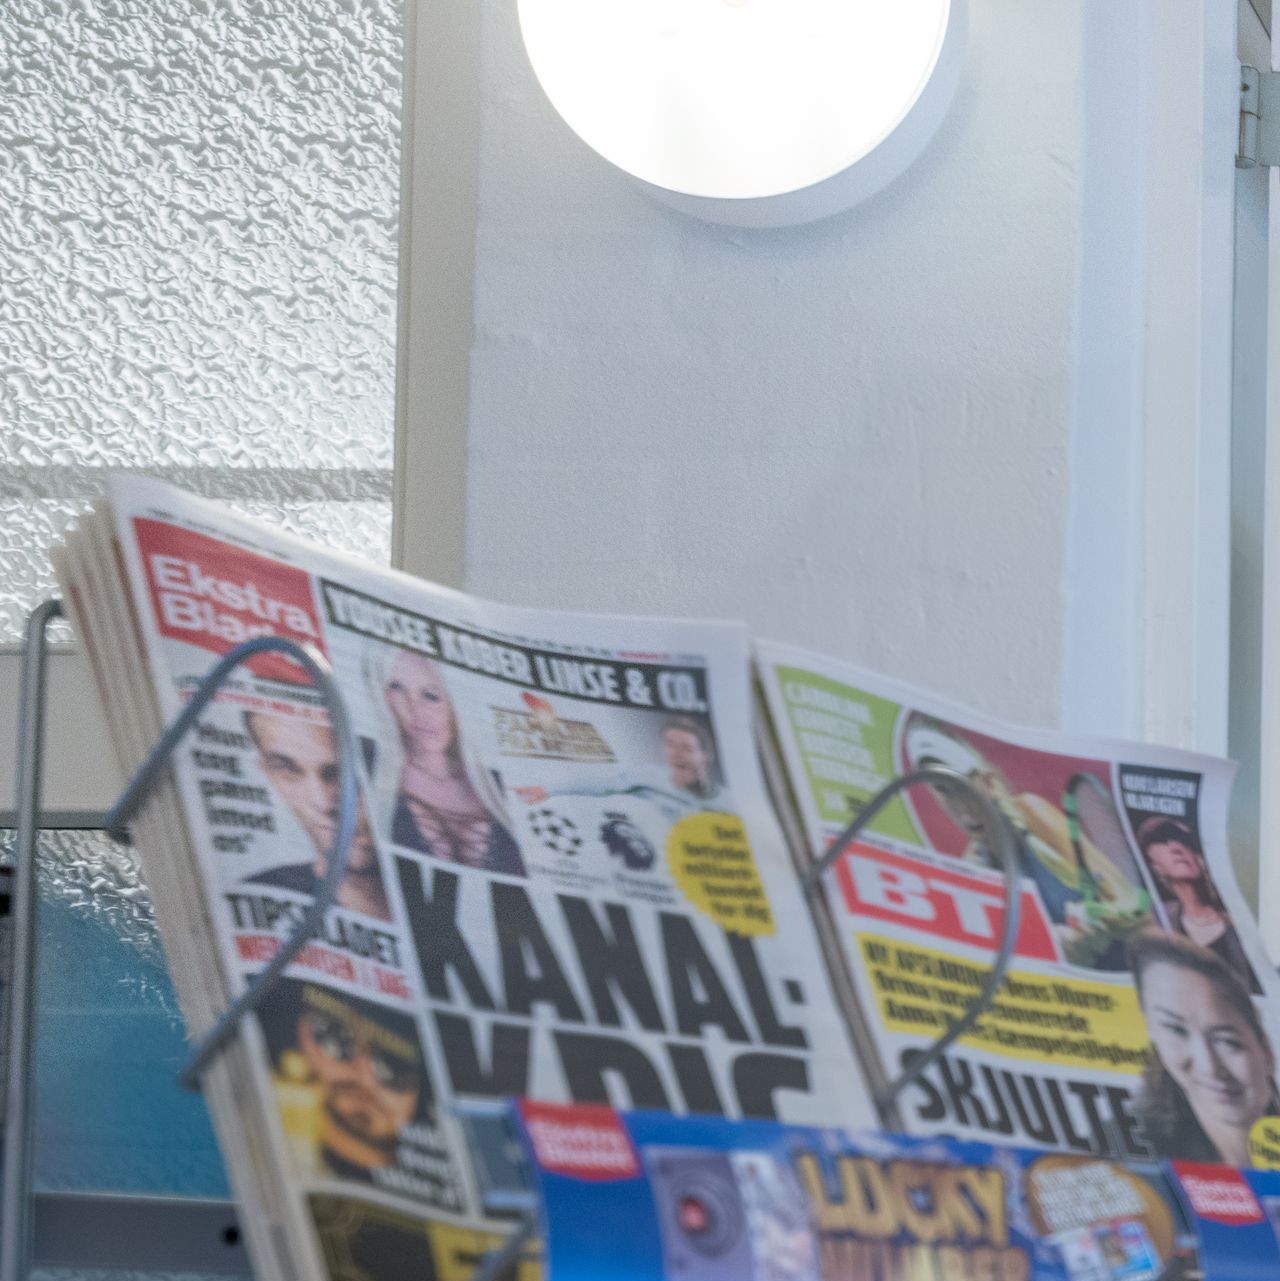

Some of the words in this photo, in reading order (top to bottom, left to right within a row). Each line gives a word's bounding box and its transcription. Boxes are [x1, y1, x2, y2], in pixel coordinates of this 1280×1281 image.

[151, 554, 320, 638] Ekstra
[537, 651, 621, 703] LINSE
[623, 668, 656, 708] &
[847, 856, 1005, 940] BT
